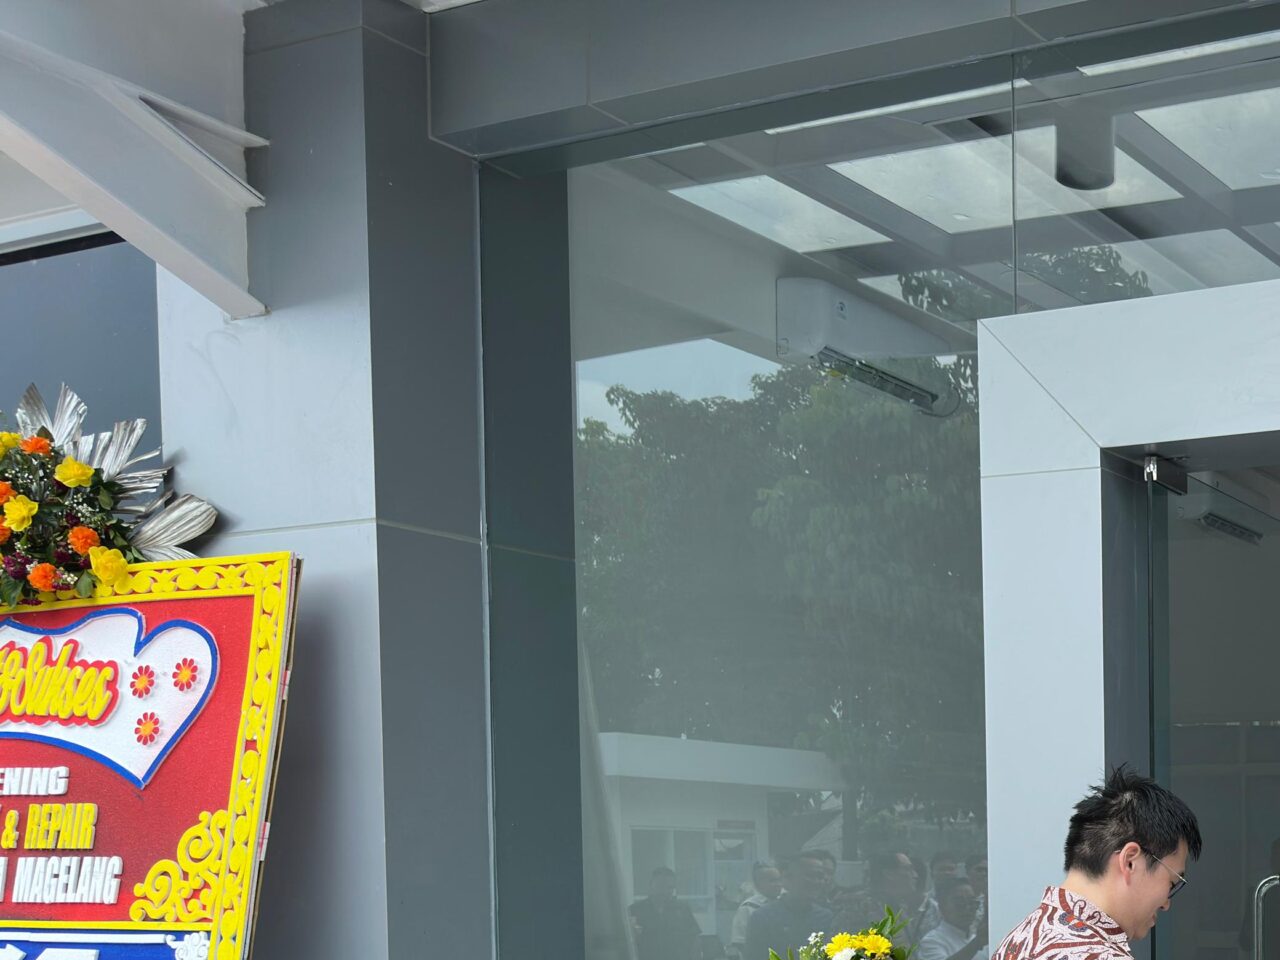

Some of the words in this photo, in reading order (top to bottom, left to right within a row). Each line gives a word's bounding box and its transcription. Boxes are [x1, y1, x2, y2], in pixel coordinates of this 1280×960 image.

[25, 641, 114, 720] Sukses
[1, 810, 19, 849] &
[24, 803, 98, 850] REPAIR
[12, 856, 123, 904] MAGELANG
